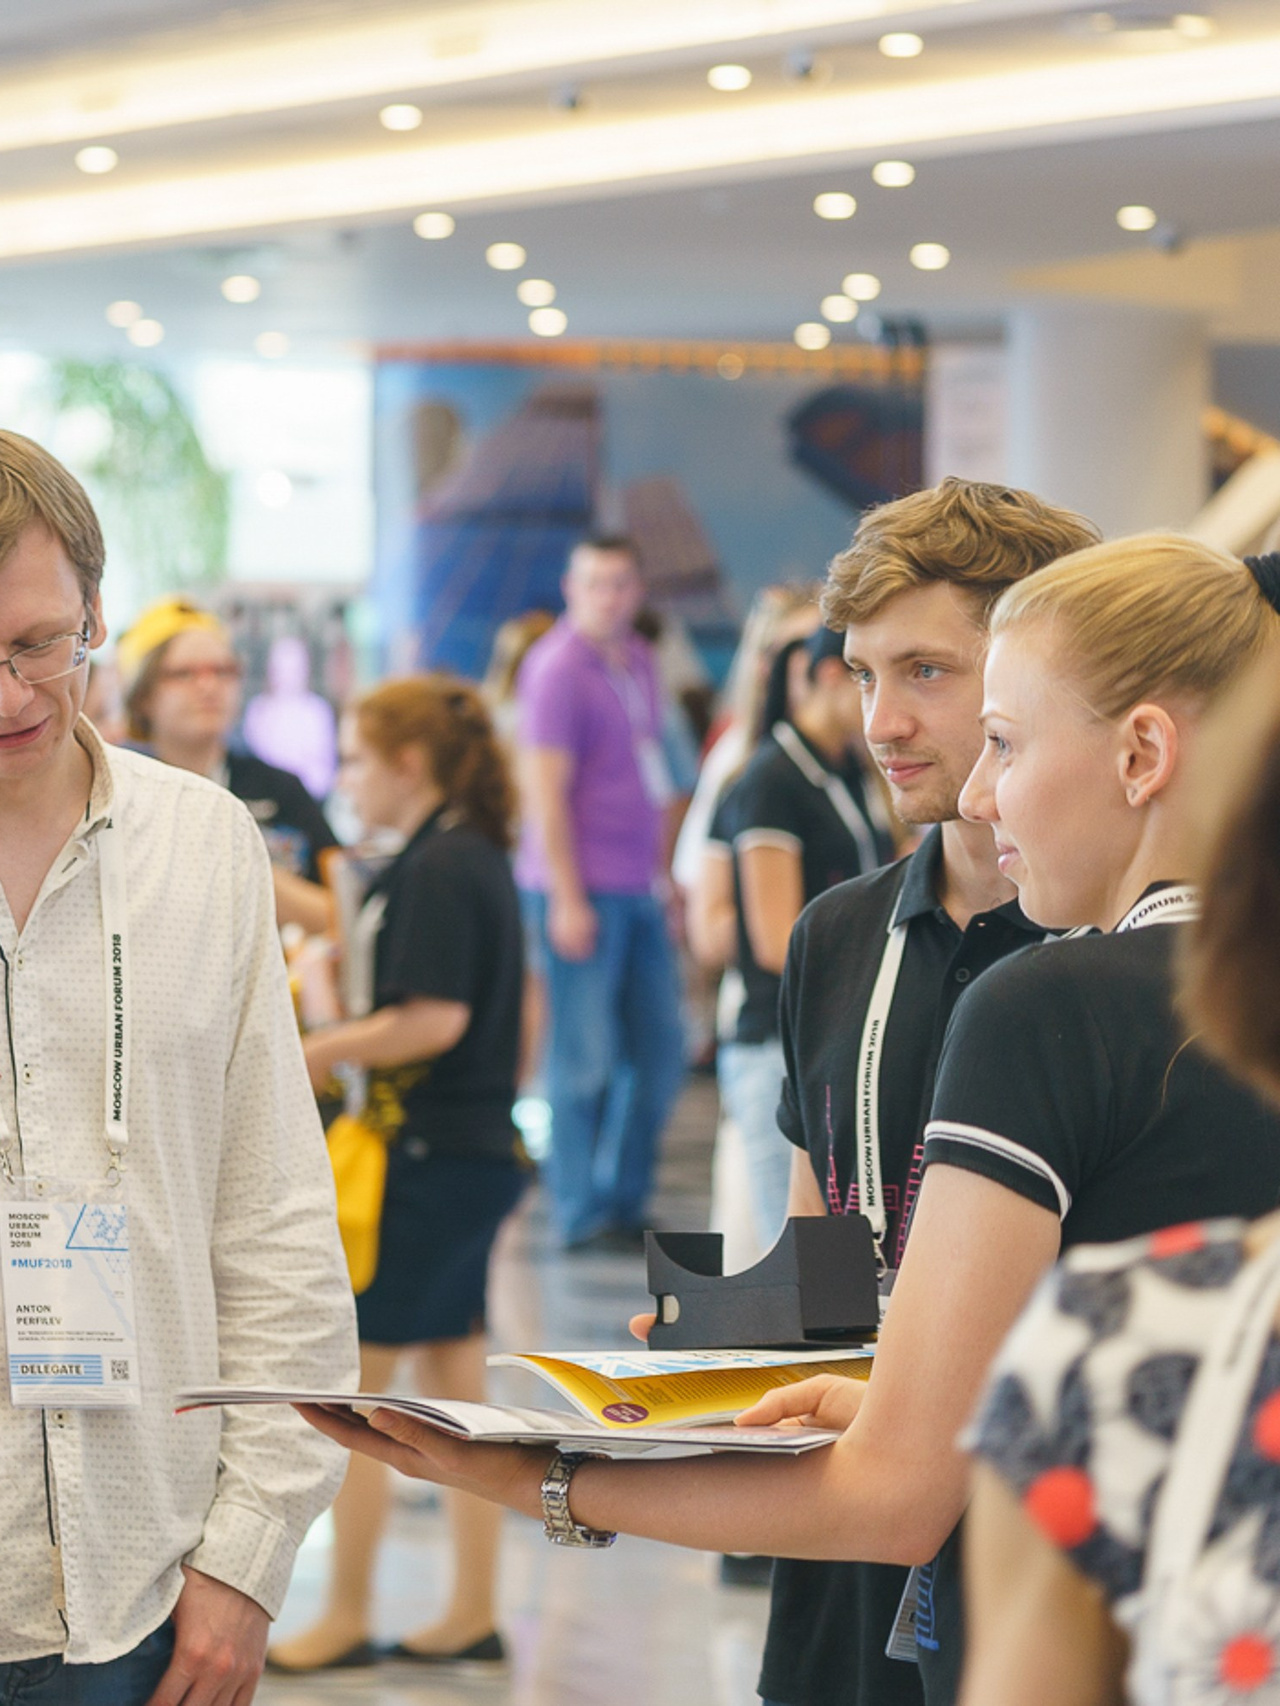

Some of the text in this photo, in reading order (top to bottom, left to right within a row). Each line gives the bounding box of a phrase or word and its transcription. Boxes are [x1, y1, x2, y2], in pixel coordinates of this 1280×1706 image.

[1132, 894, 1183, 925] FORUM
[112, 934, 123, 1121] MOSCOW URBAN FORUM 2018
[863, 1020, 879, 1207] MOSCOW URBAN FORUM 2018
[10, 1240, 32, 1248] 2018
[11, 1258, 72, 1268] #MUF2018
[16, 1305, 51, 1313] ANTON
[20, 1364, 81, 1375] DELEGATE
